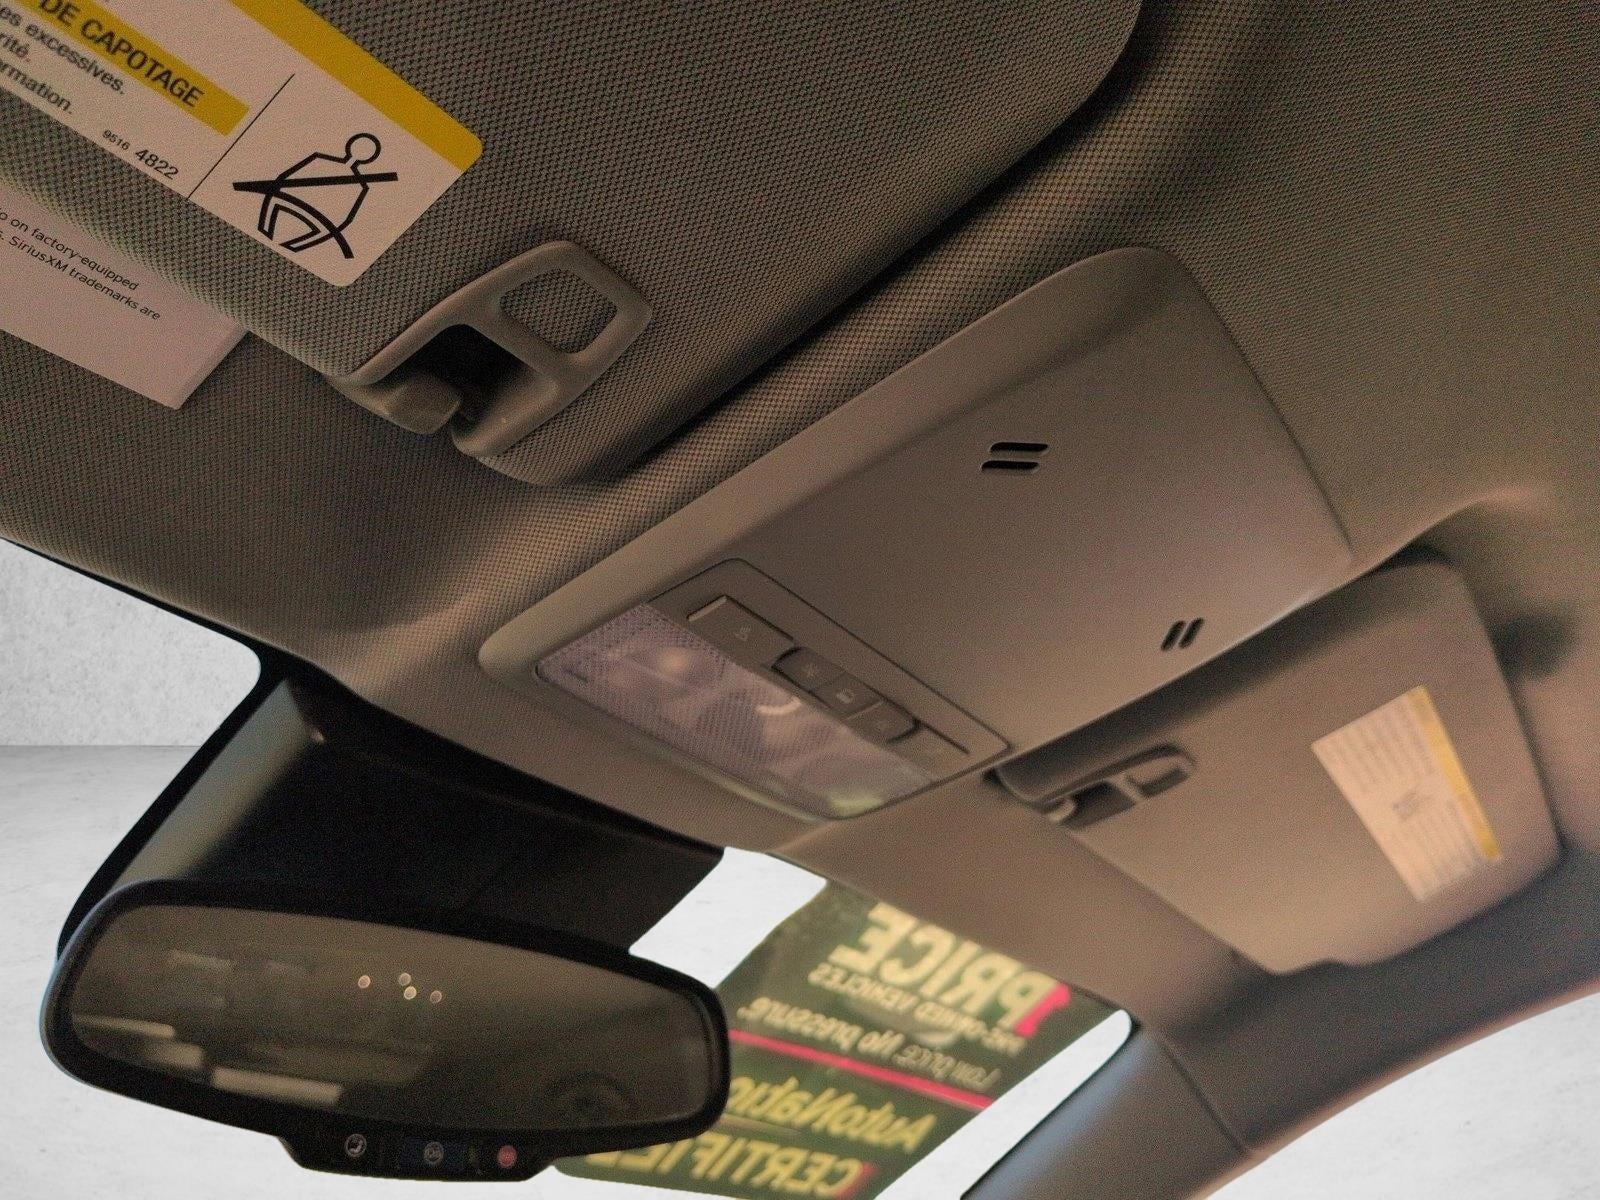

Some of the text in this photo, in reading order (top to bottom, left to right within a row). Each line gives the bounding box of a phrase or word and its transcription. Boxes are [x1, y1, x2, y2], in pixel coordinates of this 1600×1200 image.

[25, 23, 125, 95] excessives.
[39, 0, 205, 108] DE CAPOTAGE
[102, 129, 180, 181] 9516 4822
[9, 235, 161, 321] SiriusXM trademarks are
[10, 219, 29, 232] on
[31, 228, 140, 292] factory-equipped
